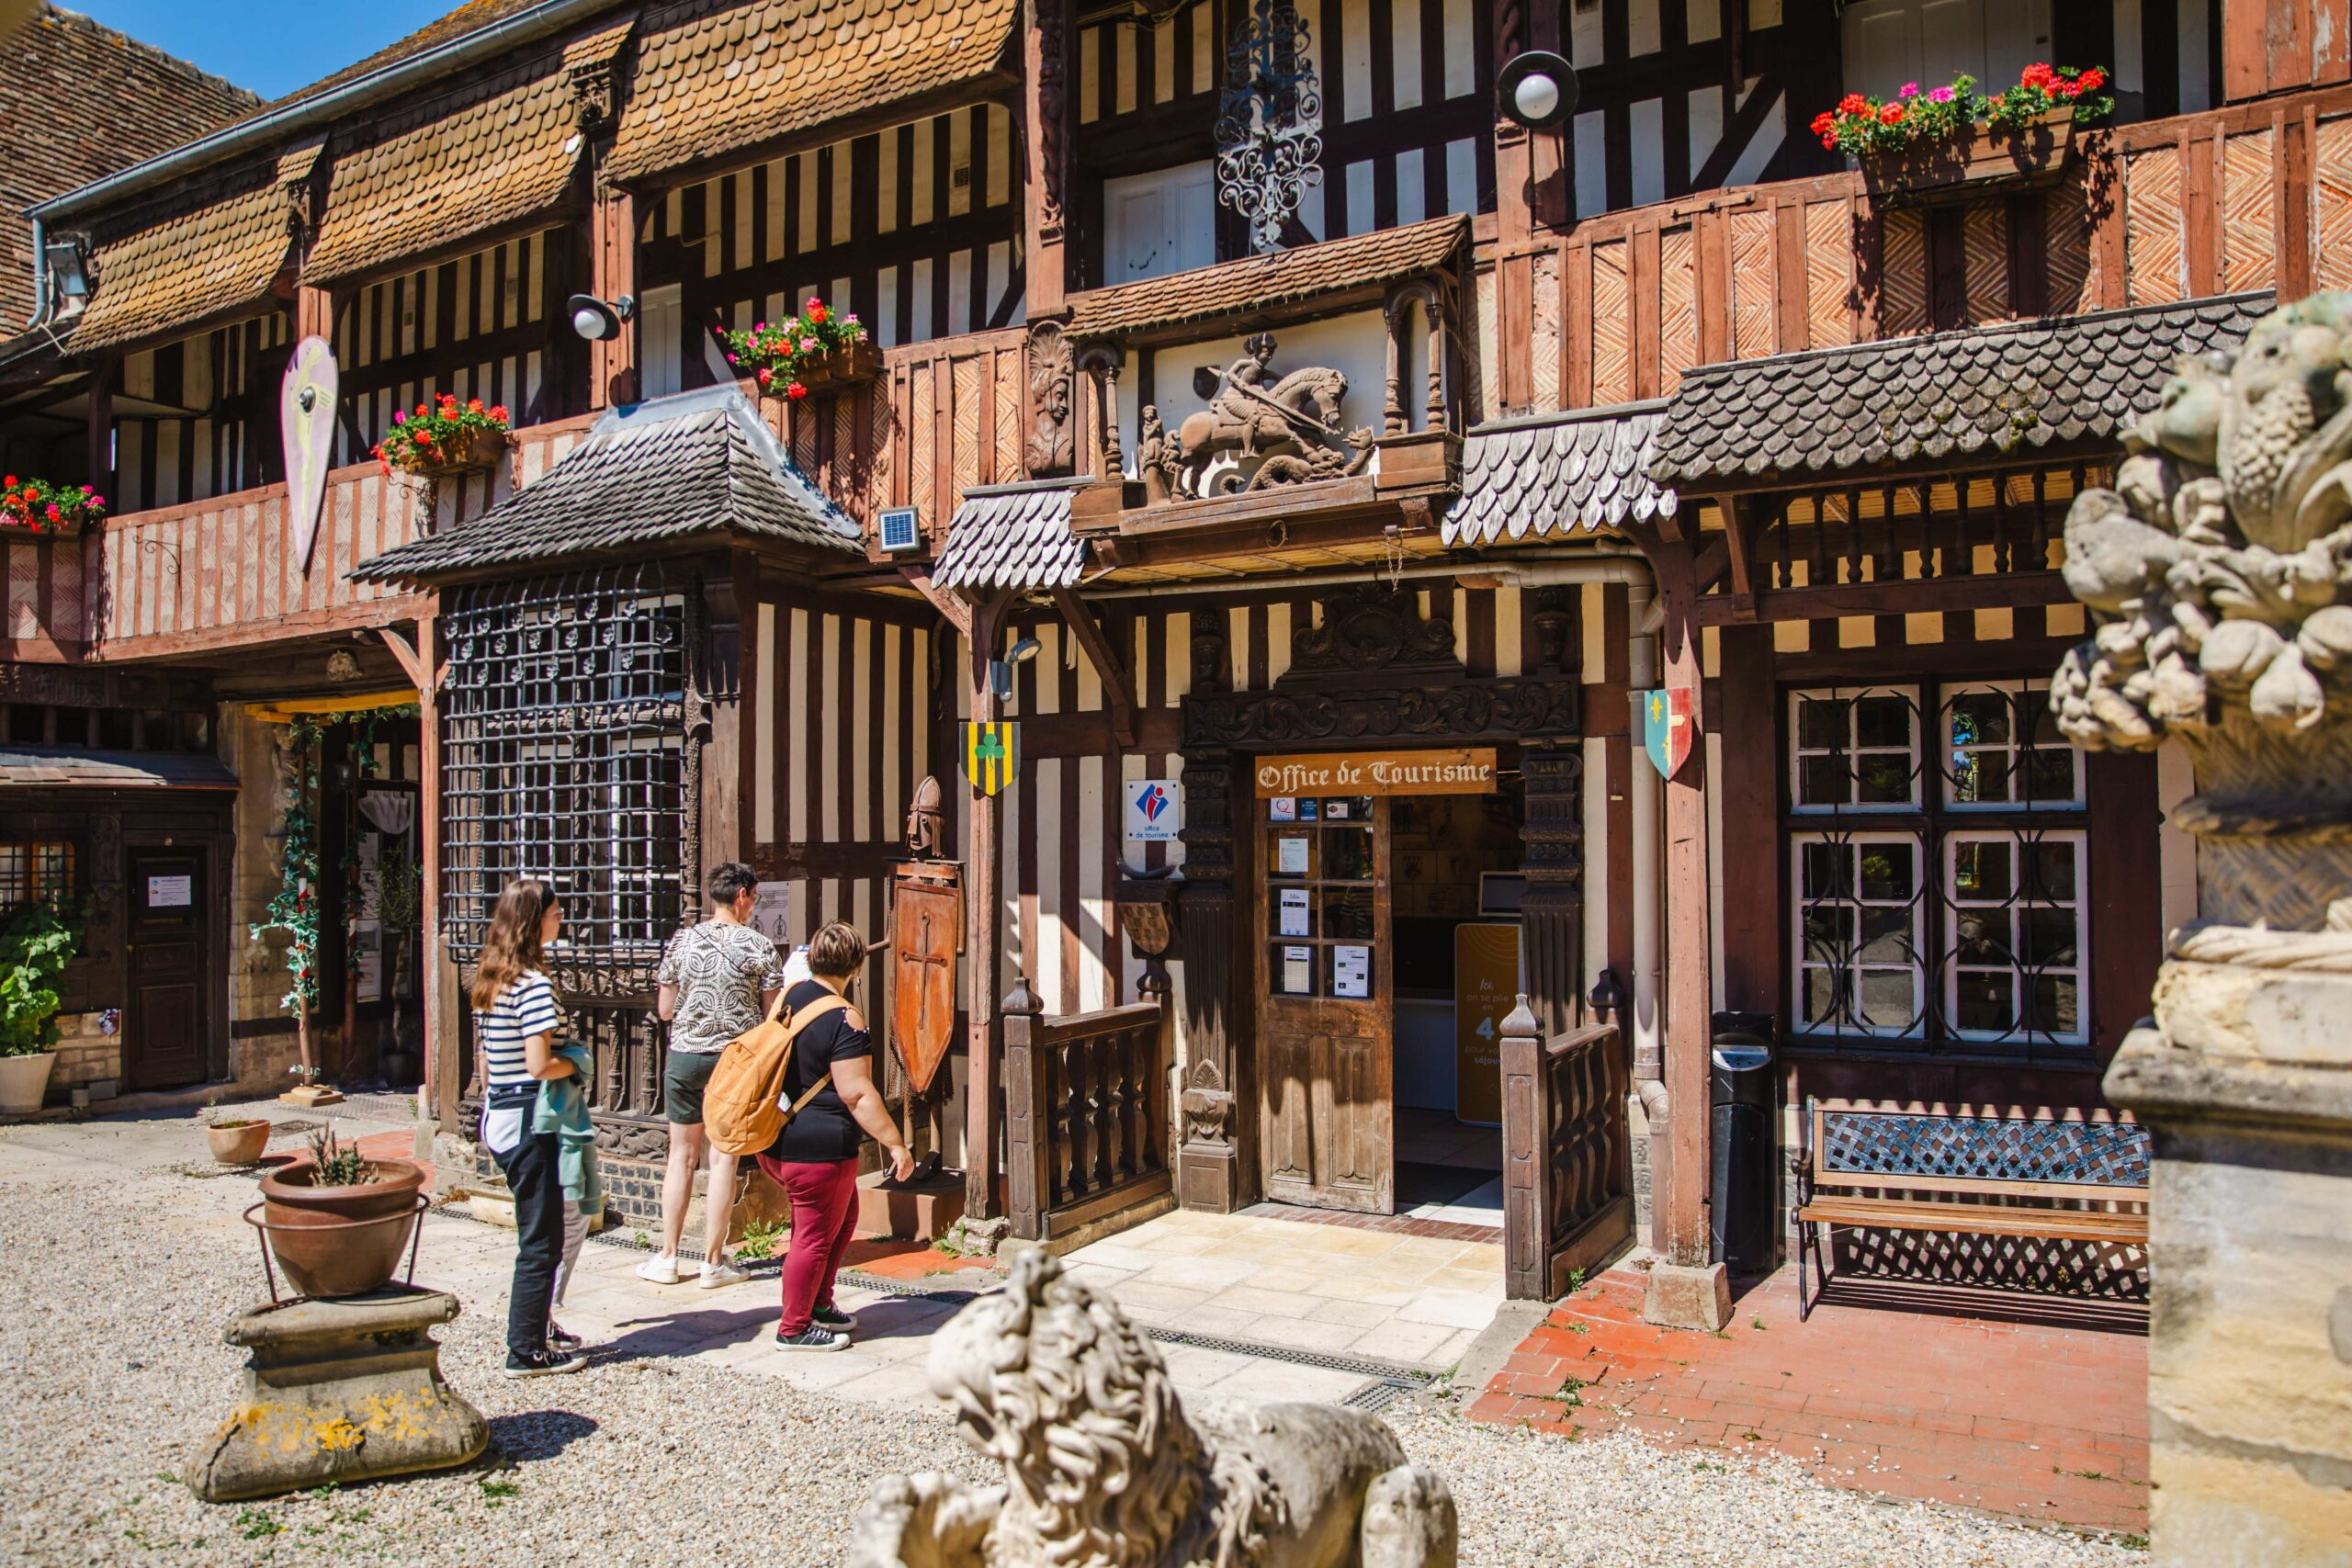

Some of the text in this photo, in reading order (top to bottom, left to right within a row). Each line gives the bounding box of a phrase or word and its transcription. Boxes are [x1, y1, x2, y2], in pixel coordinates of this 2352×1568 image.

[1258, 760, 1490, 793] Office de Tourisme
[1476, 1016, 1495, 1041] 4
